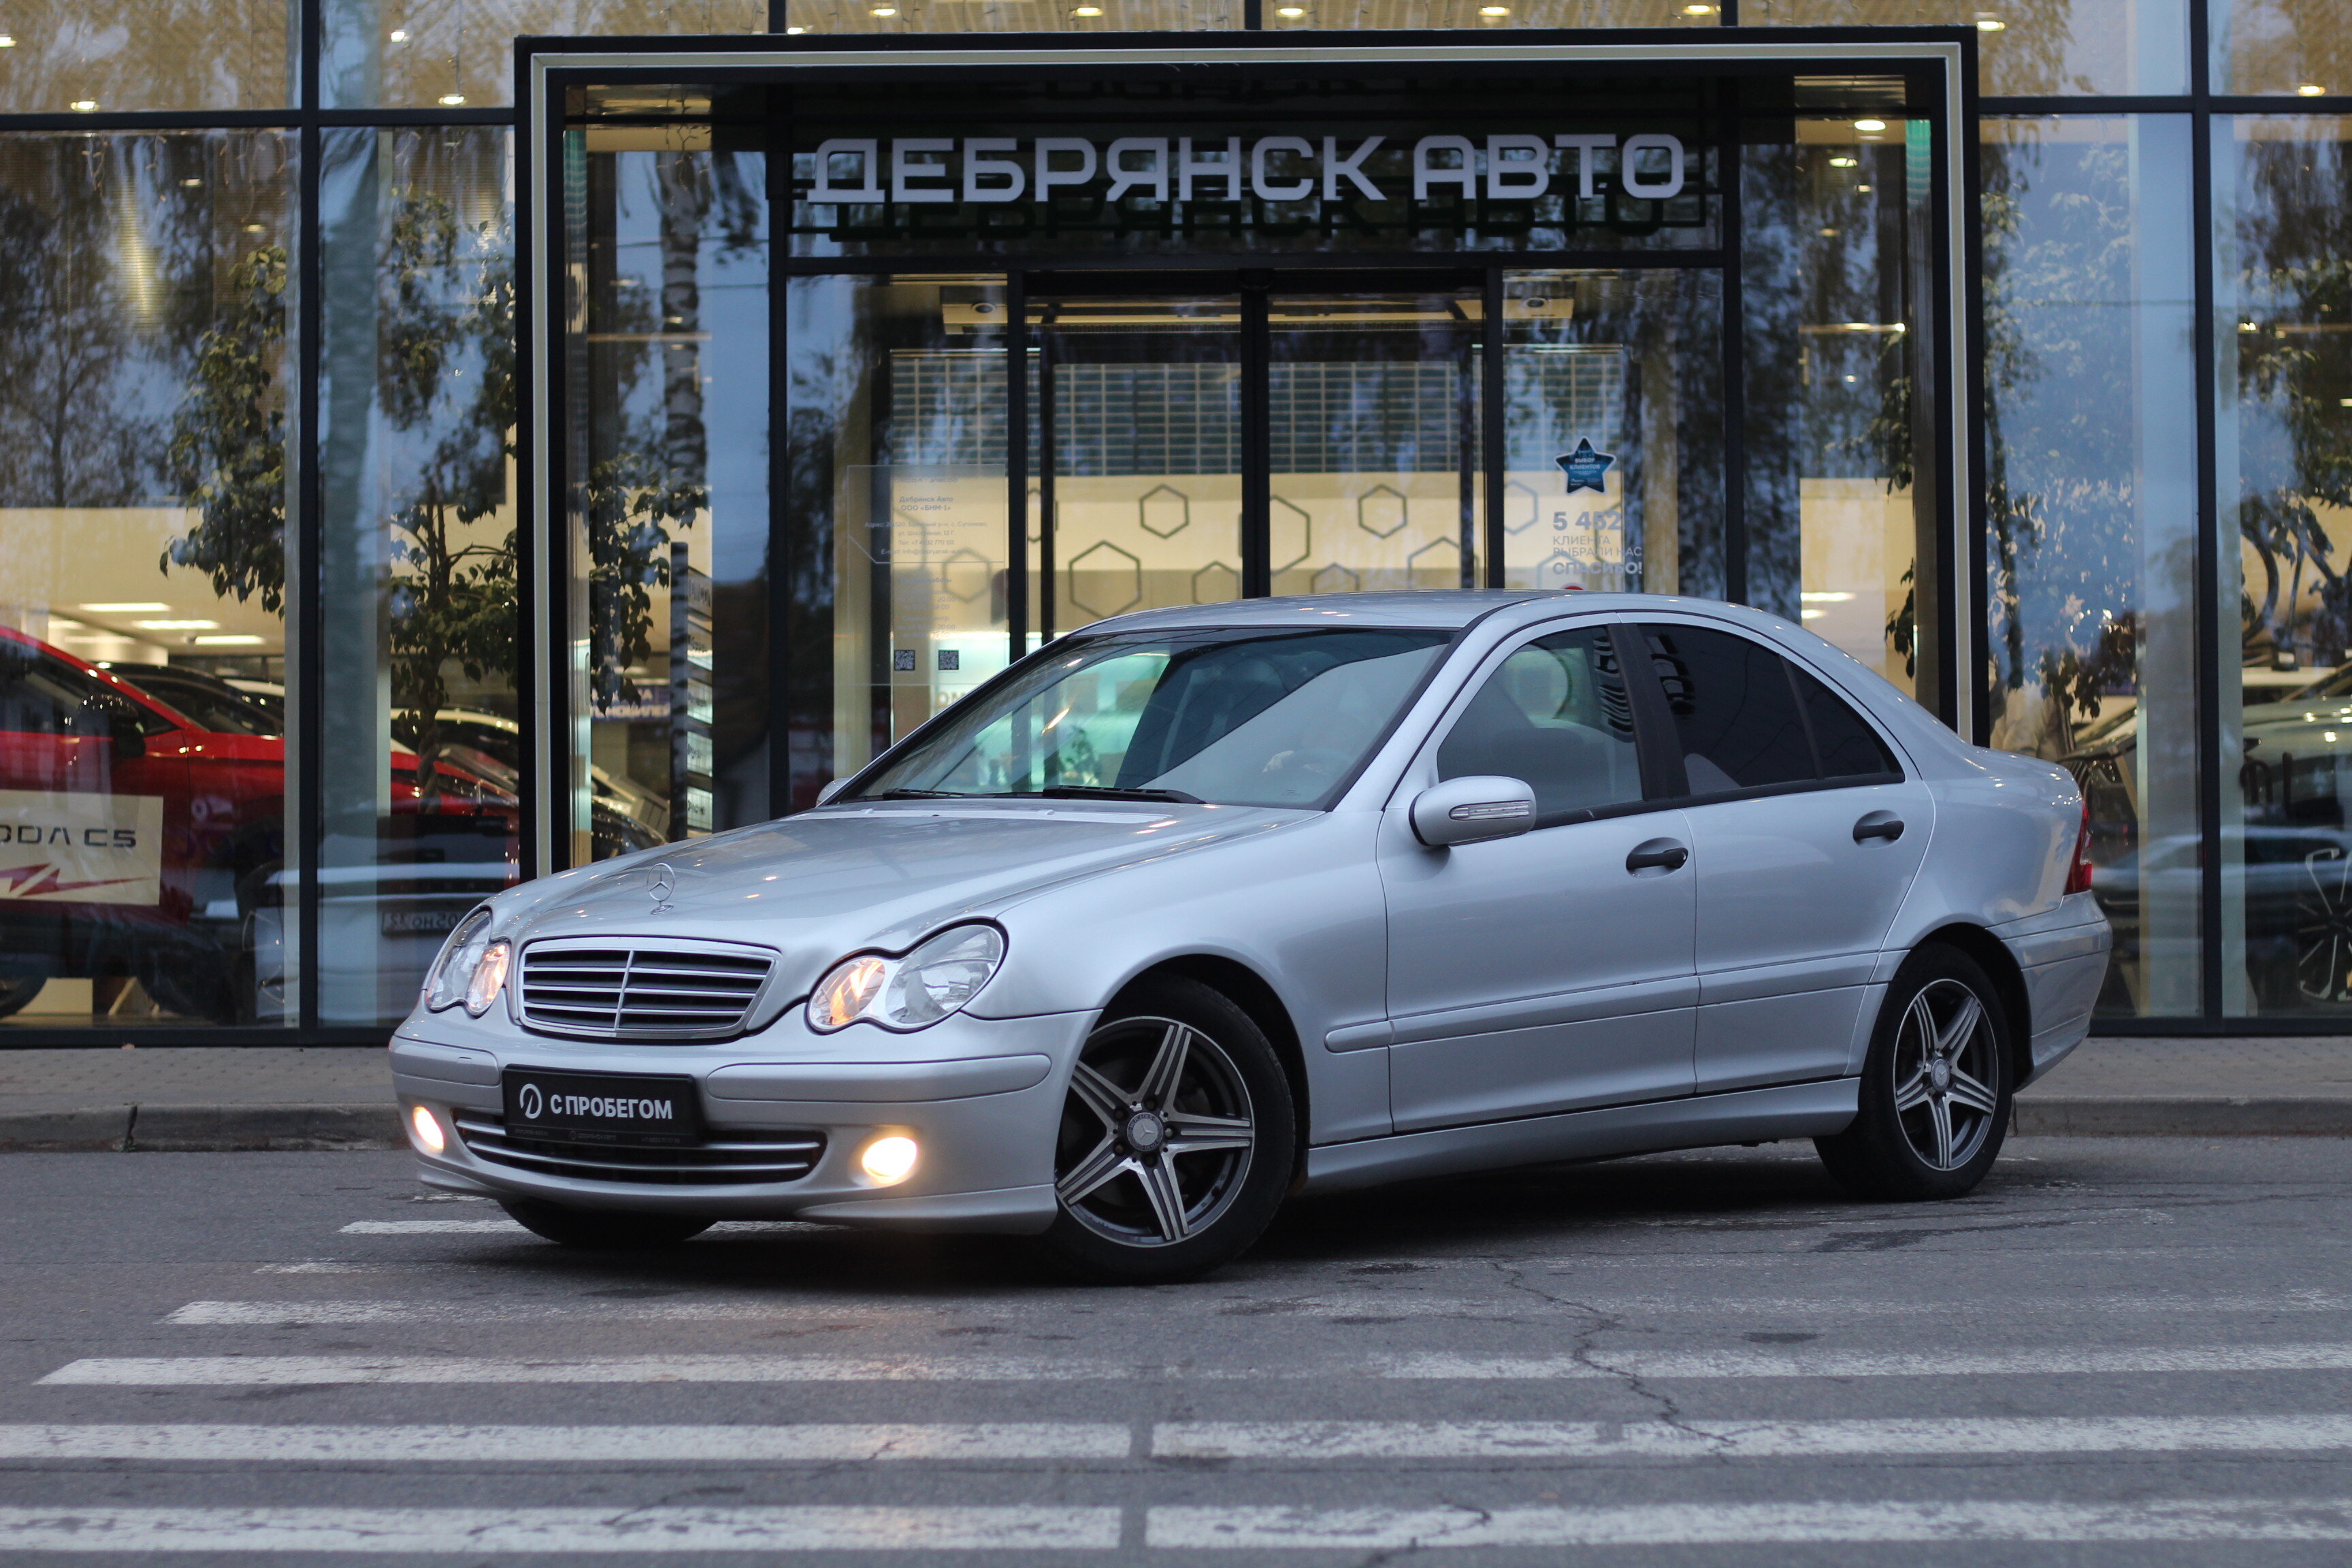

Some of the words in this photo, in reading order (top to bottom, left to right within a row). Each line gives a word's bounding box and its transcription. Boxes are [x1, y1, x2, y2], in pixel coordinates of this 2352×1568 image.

[807, 135, 1387, 202] ДЕБРЯНСК
[1413, 134, 1684, 200] АВТО
[1553, 511, 1568, 531] 5
[1575, 511, 1622, 531] 452
[1553, 536, 1611, 545] КЛИЕНТА
[1553, 546, 1613, 557] ВЫБРАЛИ
[1616, 546, 1642, 556] НАС
[1552, 561, 1643, 575] СПАСИБО!
[84, 828, 137, 847] C5
[551, 1094, 563, 1114] С
[565, 1095, 672, 1120] ПРОБЕГОМ
